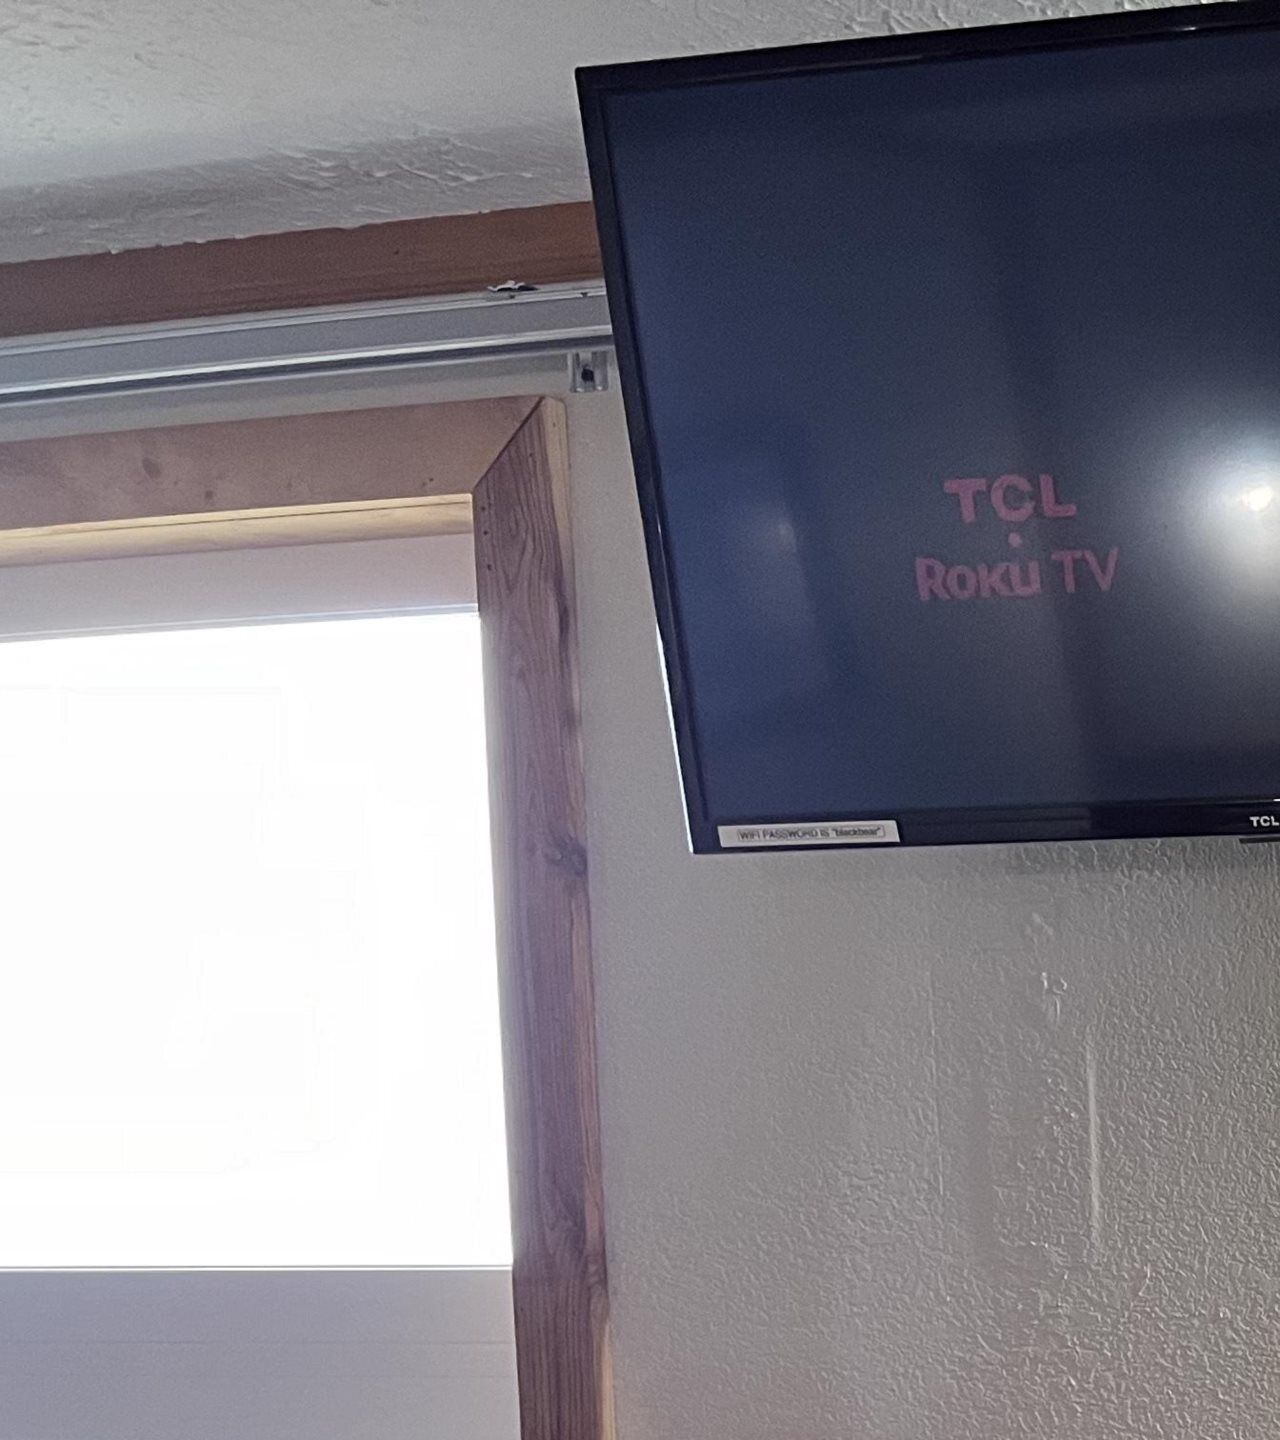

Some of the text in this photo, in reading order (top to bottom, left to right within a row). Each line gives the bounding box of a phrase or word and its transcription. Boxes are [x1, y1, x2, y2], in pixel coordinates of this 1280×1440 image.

[943, 473, 1077, 523] TCL
[1050, 546, 1120, 593] TV
[1249, 815, 1280, 828] TCL
